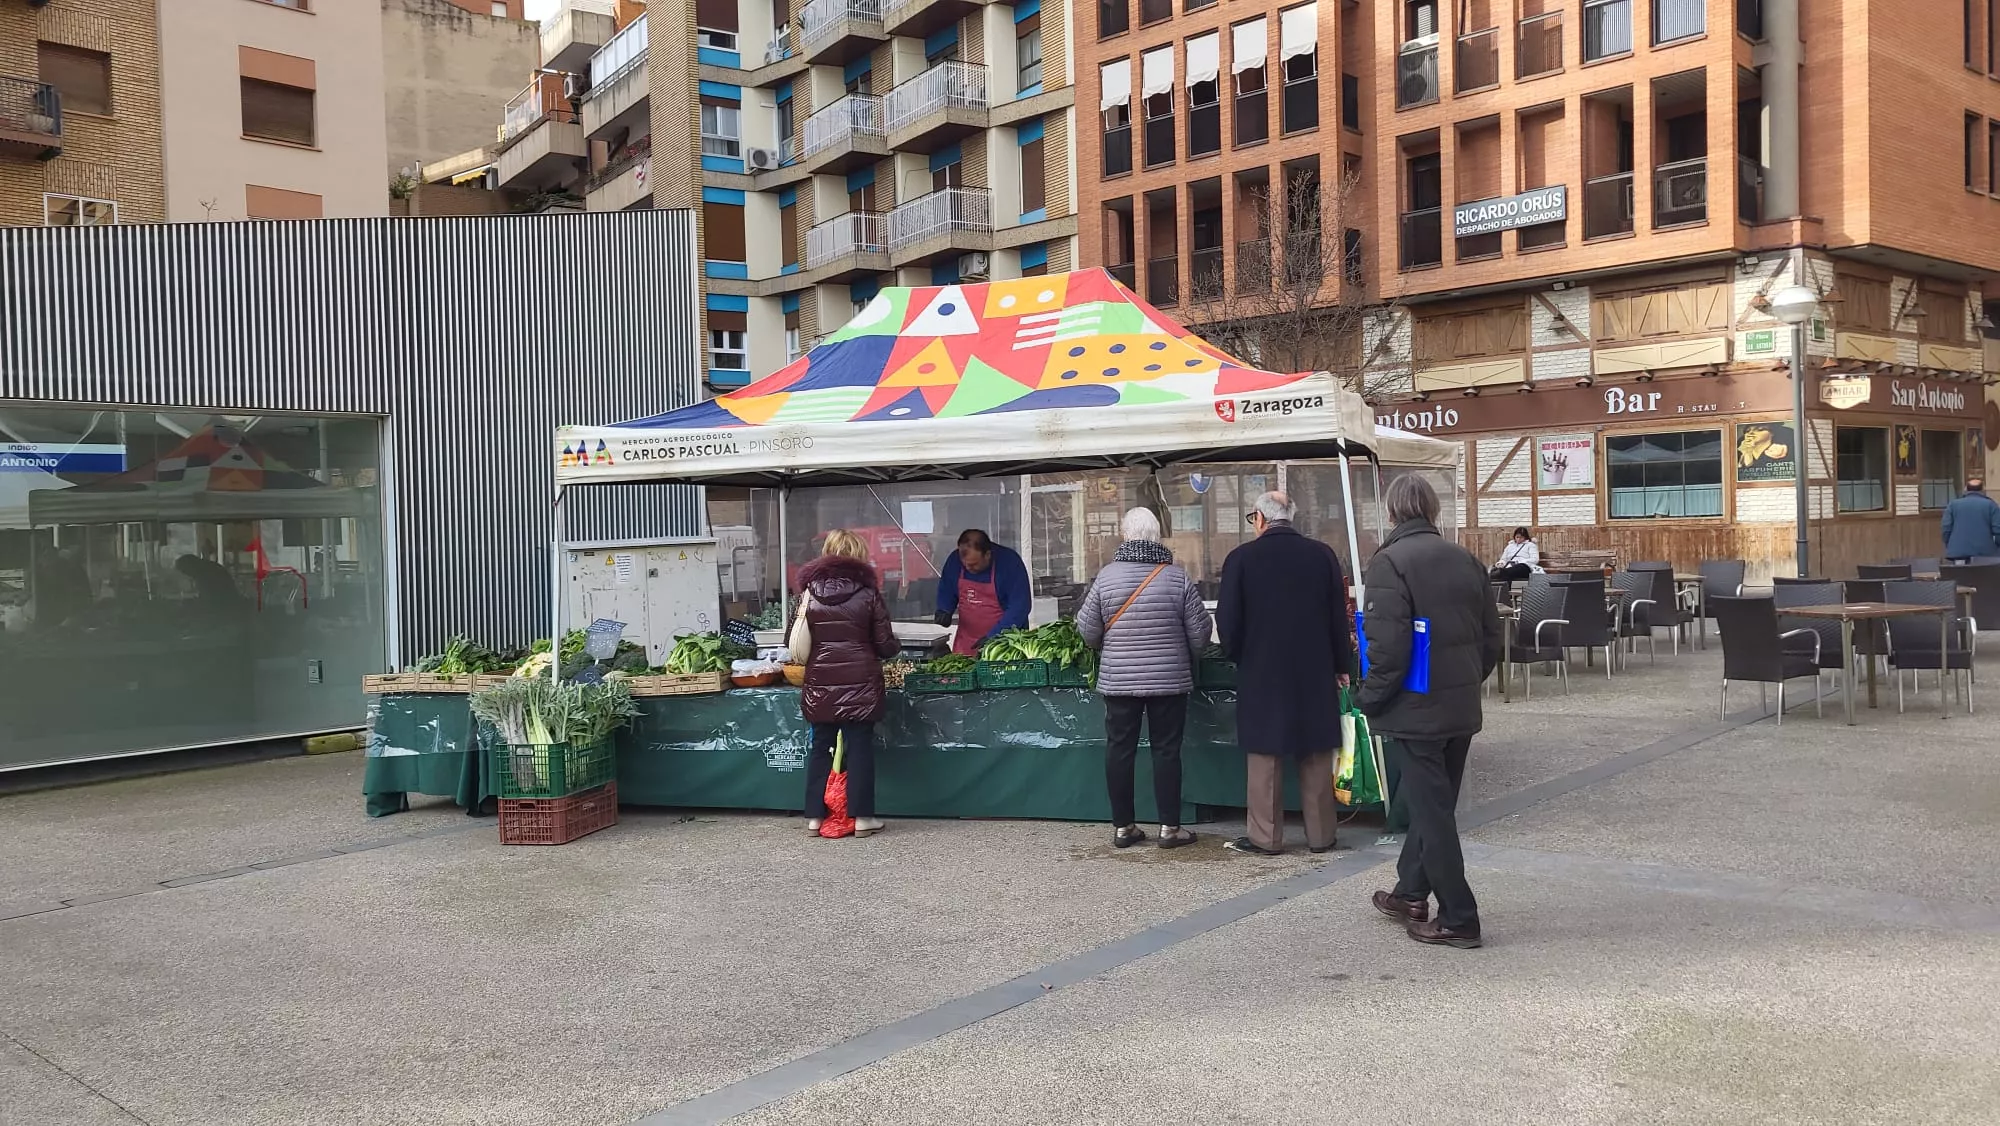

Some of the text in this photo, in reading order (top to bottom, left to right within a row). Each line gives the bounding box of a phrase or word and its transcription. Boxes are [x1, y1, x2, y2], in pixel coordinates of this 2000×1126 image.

[1455, 190, 1562, 225] RICARDO ORÚS
[1456, 209, 1562, 235] DESPACHO DE ABOGADOS
[1604, 387, 1662, 414] Bar
[1824, 386, 1863, 397] AMBAR
[1891, 379, 1965, 413] San Antonio
[1240, 396, 1324, 415] Zaragoza
[1376, 404, 1459, 432] ntonio
[623, 436, 814, 461] CARLOS PASCUAL PINSORO
[0, 458, 59, 467] ANTONIO
